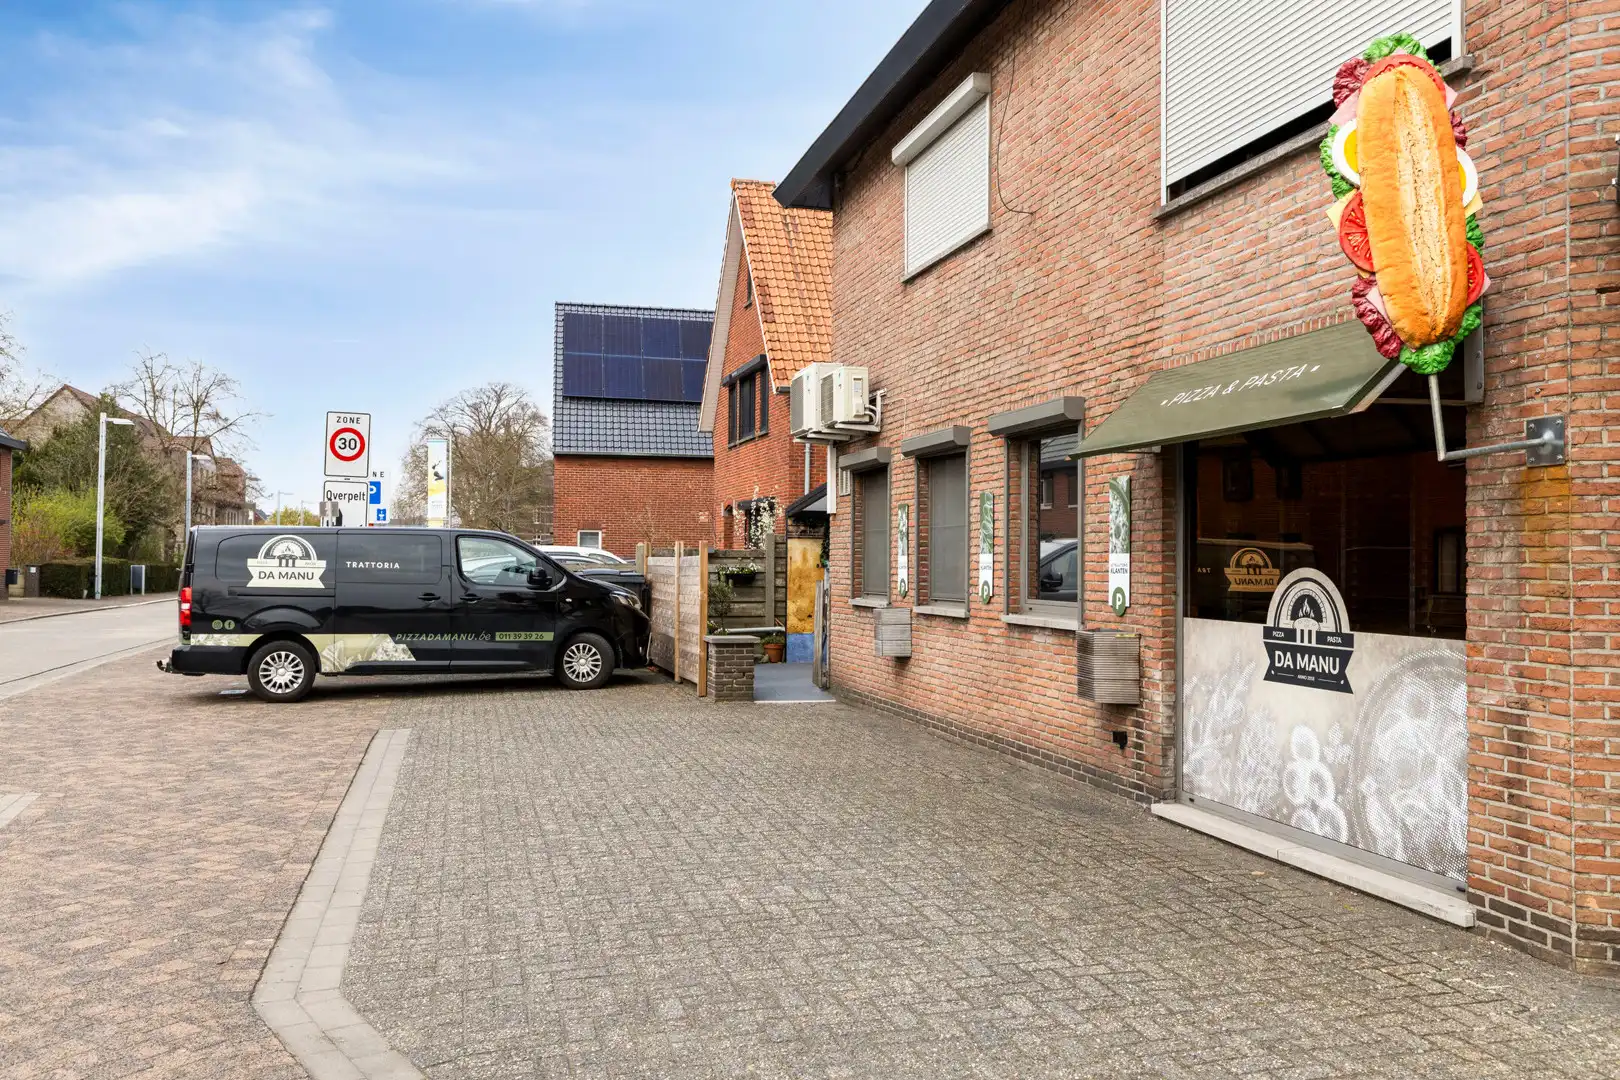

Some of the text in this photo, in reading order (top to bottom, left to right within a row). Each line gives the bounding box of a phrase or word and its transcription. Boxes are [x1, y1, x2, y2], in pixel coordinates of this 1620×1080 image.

[1167, 364, 1307, 407] PIZZA & PASTA
[336, 416, 361, 424] ZONE
[338, 438, 357, 450] 30
[346, 561, 400, 569] TRATTORIA
[258, 570, 314, 581] DA MANU
[1116, 593, 1122, 608] P
[395, 631, 492, 641] PIZZADAMANU.be
[1275, 650, 1340, 674] DA MANU
